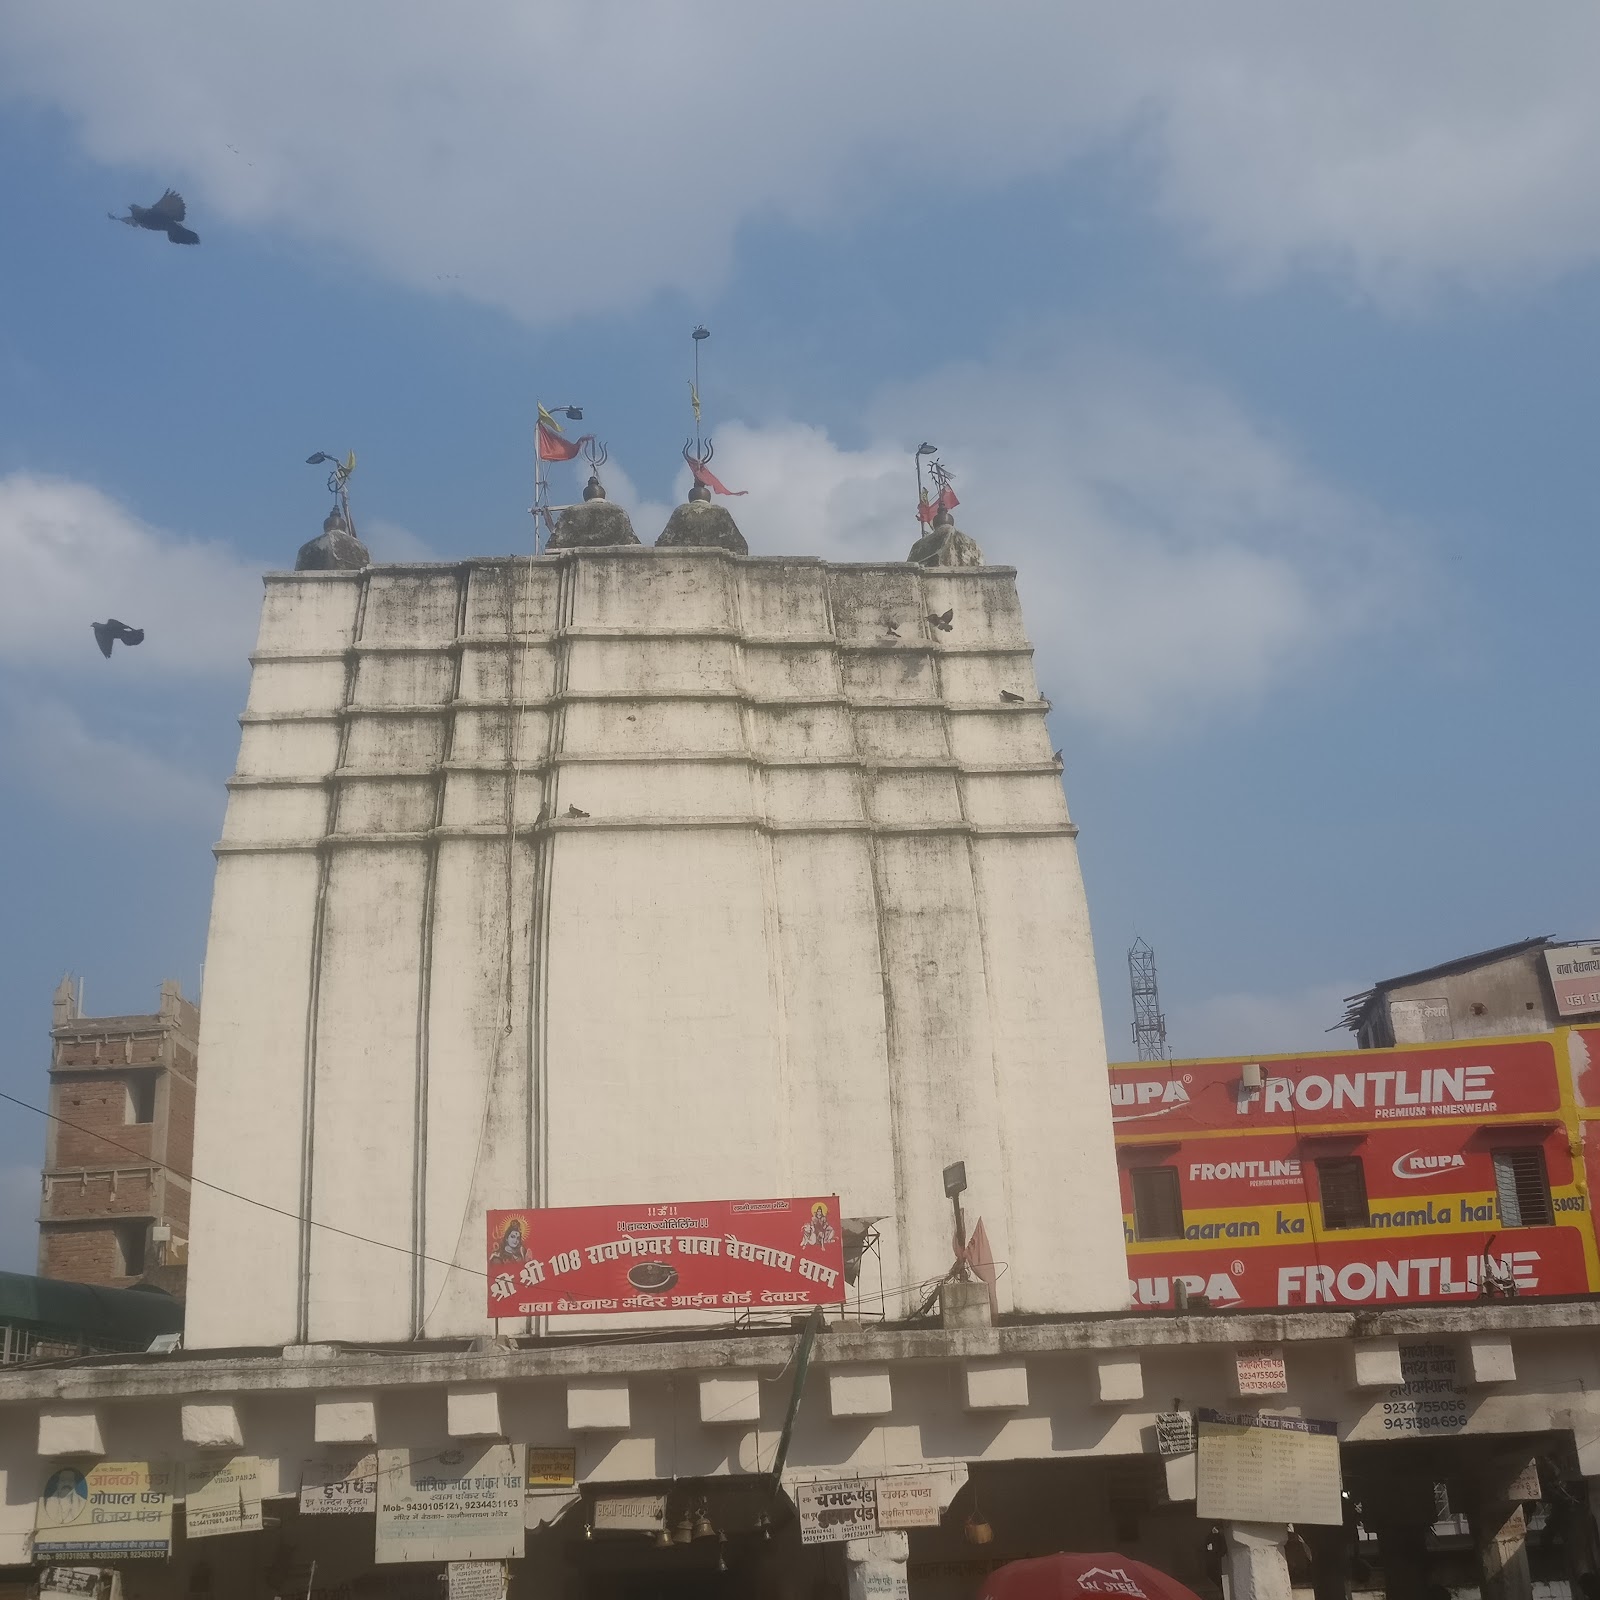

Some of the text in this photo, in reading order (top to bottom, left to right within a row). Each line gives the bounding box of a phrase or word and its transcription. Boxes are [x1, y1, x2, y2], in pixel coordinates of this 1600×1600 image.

[1110, 1066, 1495, 1115] UPA FRONTLINE
[1375, 1102, 1497, 1119] PREMIUM INNERWEAR
[1189, 1154, 1465, 1182] FRONTLINE RUPA
[1184, 1220, 1260, 1241] aaram
[1275, 1210, 1305, 1235] ka
[1370, 1201, 1452, 1228] mamla
[1552, 1197, 1585, 1212] 38037
[490, 1273, 517, 1302] श्री
[519, 1259, 546, 1288] श्री
[548, 1249, 582, 1277] 108
[585, 1234, 673, 1264] रावणेश्वर
[676, 1236, 722, 1257] बाबा
[798, 1257, 840, 1289] धाम
[1277, 1250, 1541, 1307] FRONTLINE
[518, 1302, 553, 1313] बाबा
[622, 1295, 668, 1309] मंदिर
[760, 1290, 810, 1303] देवघर
[1383, 1400, 1466, 1415] 9234755056
[1383, 1415, 1468, 1430] 9431384696
[90, 1471, 140, 1487] जानकी
[503, 1474, 522, 1489] पंडा
[90, 1490, 137, 1505] गोपाल
[481, 1490, 497, 1500] पंड
[382, 1499, 519, 1513] Mob- 9430105121, 9234431163
